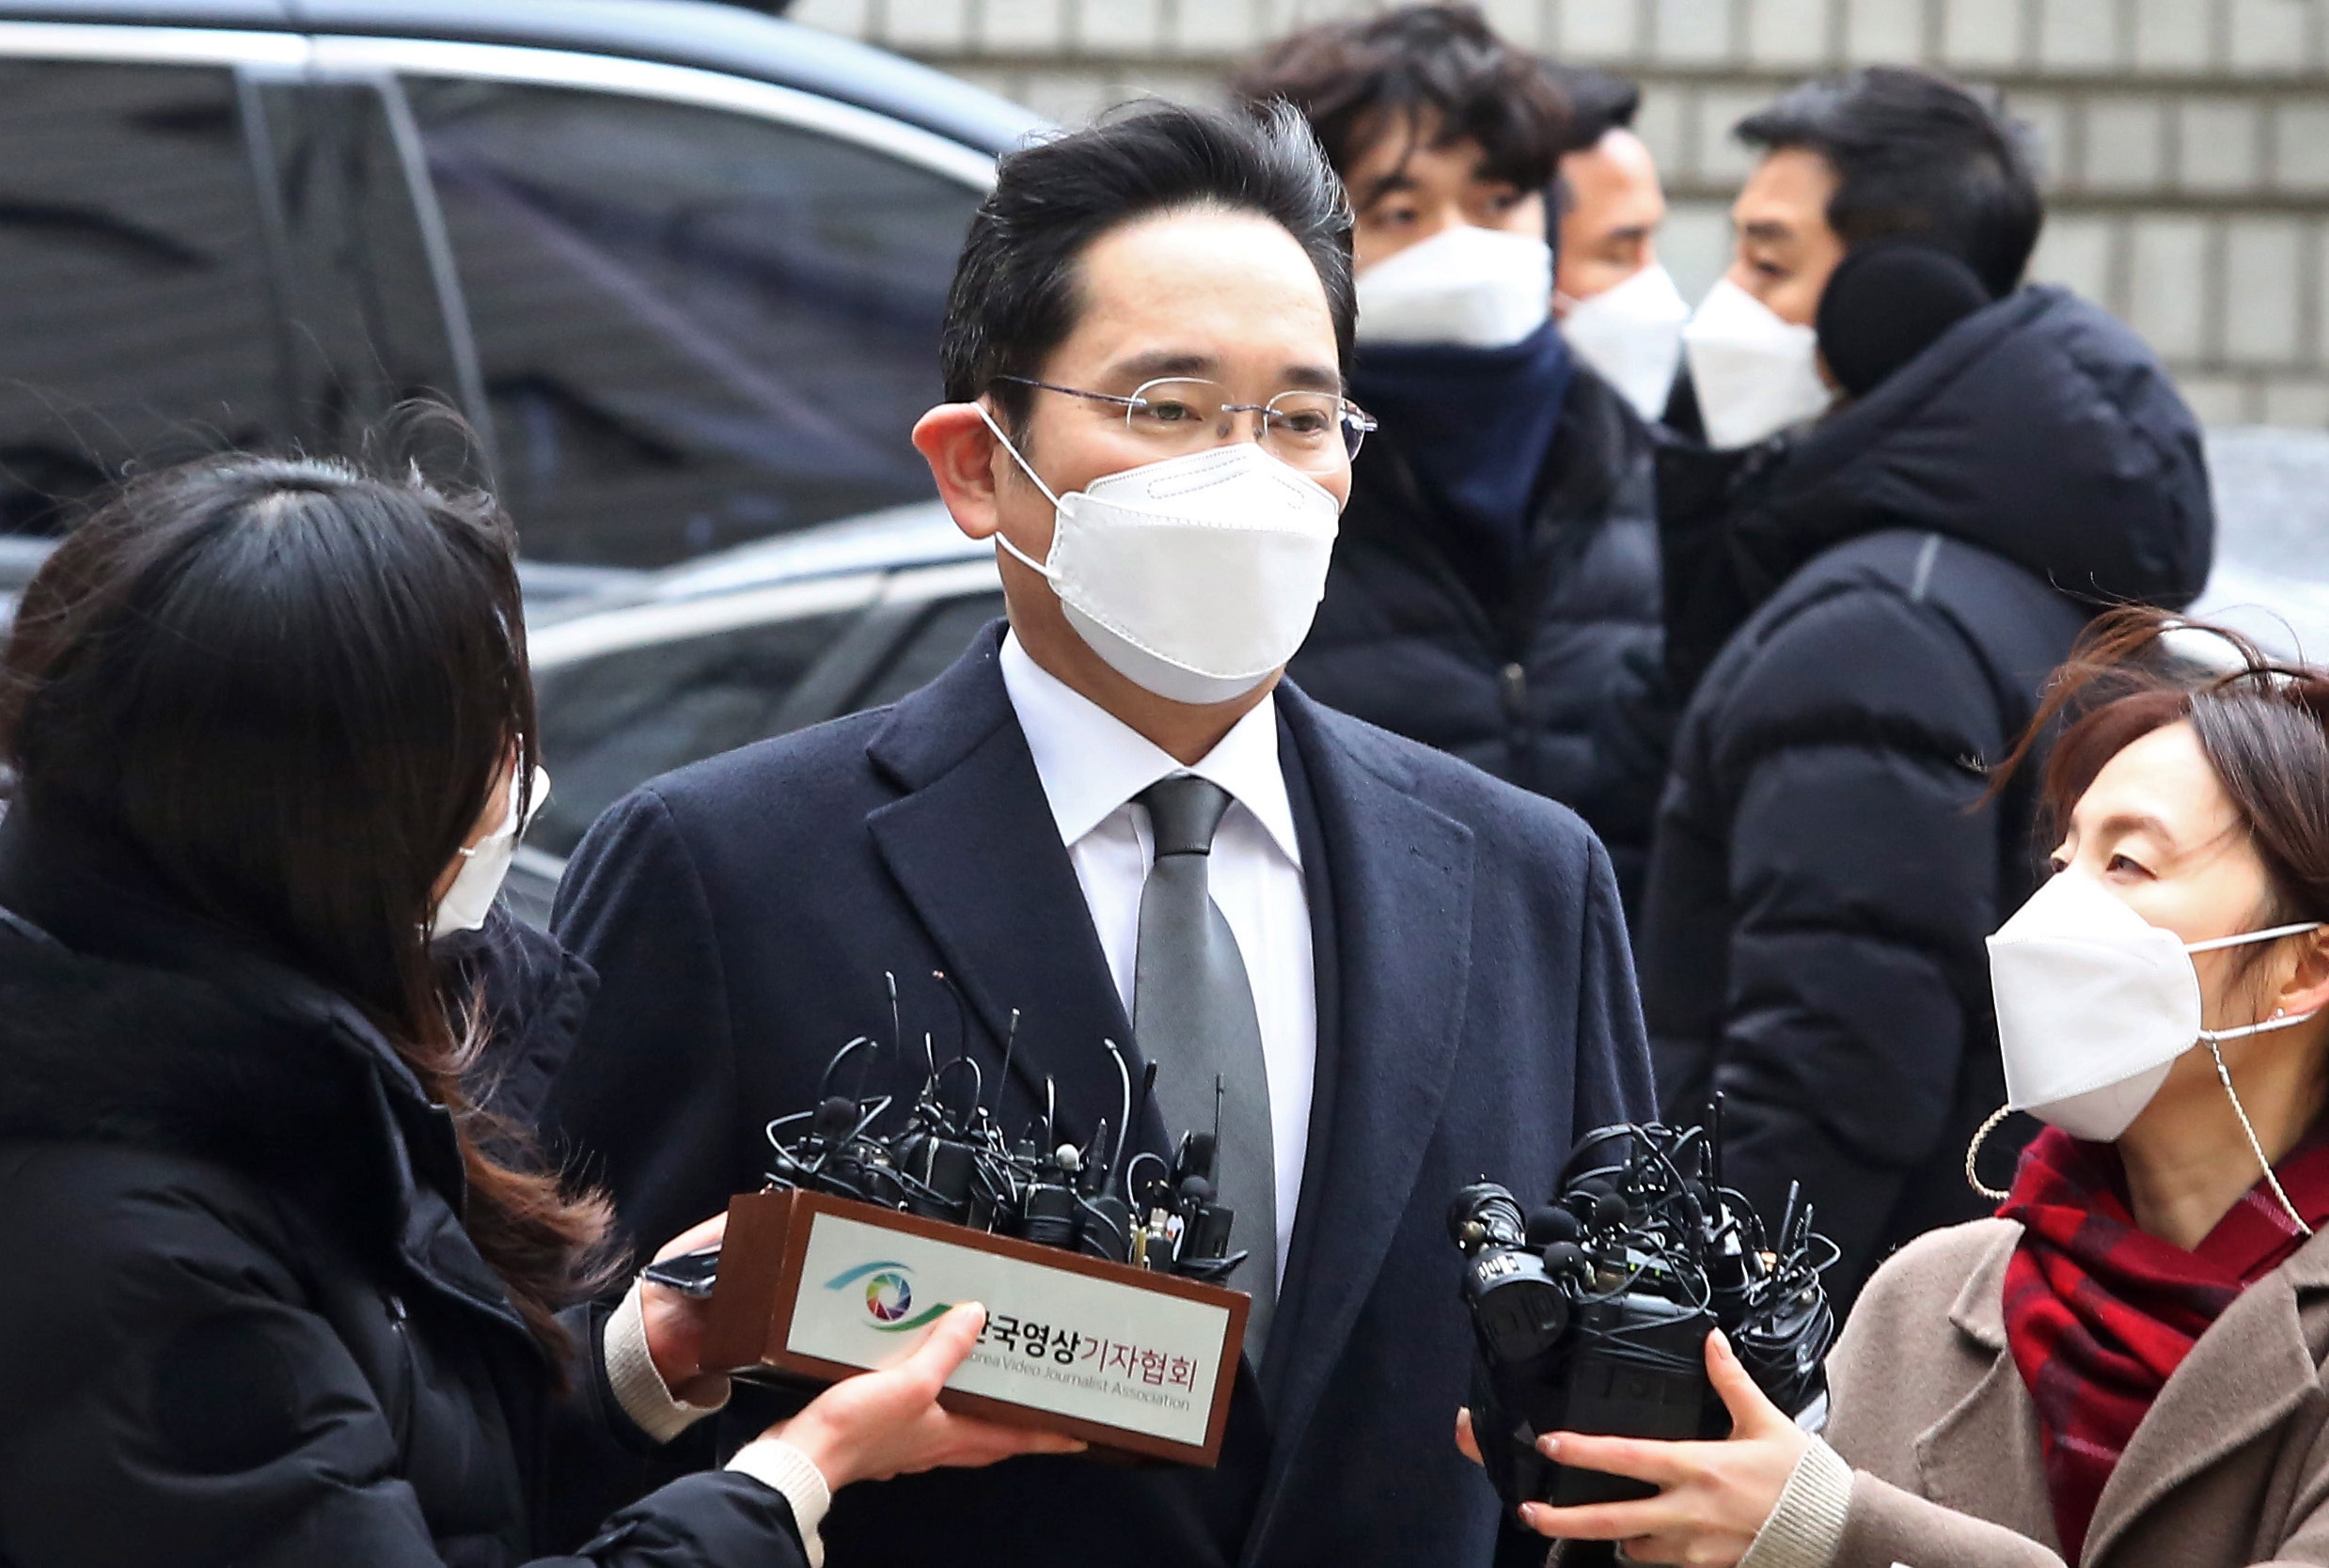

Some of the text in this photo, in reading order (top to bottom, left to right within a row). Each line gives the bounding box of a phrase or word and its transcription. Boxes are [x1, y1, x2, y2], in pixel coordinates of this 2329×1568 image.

[969, 1353, 1190, 1411] orea Video Journalist Association
